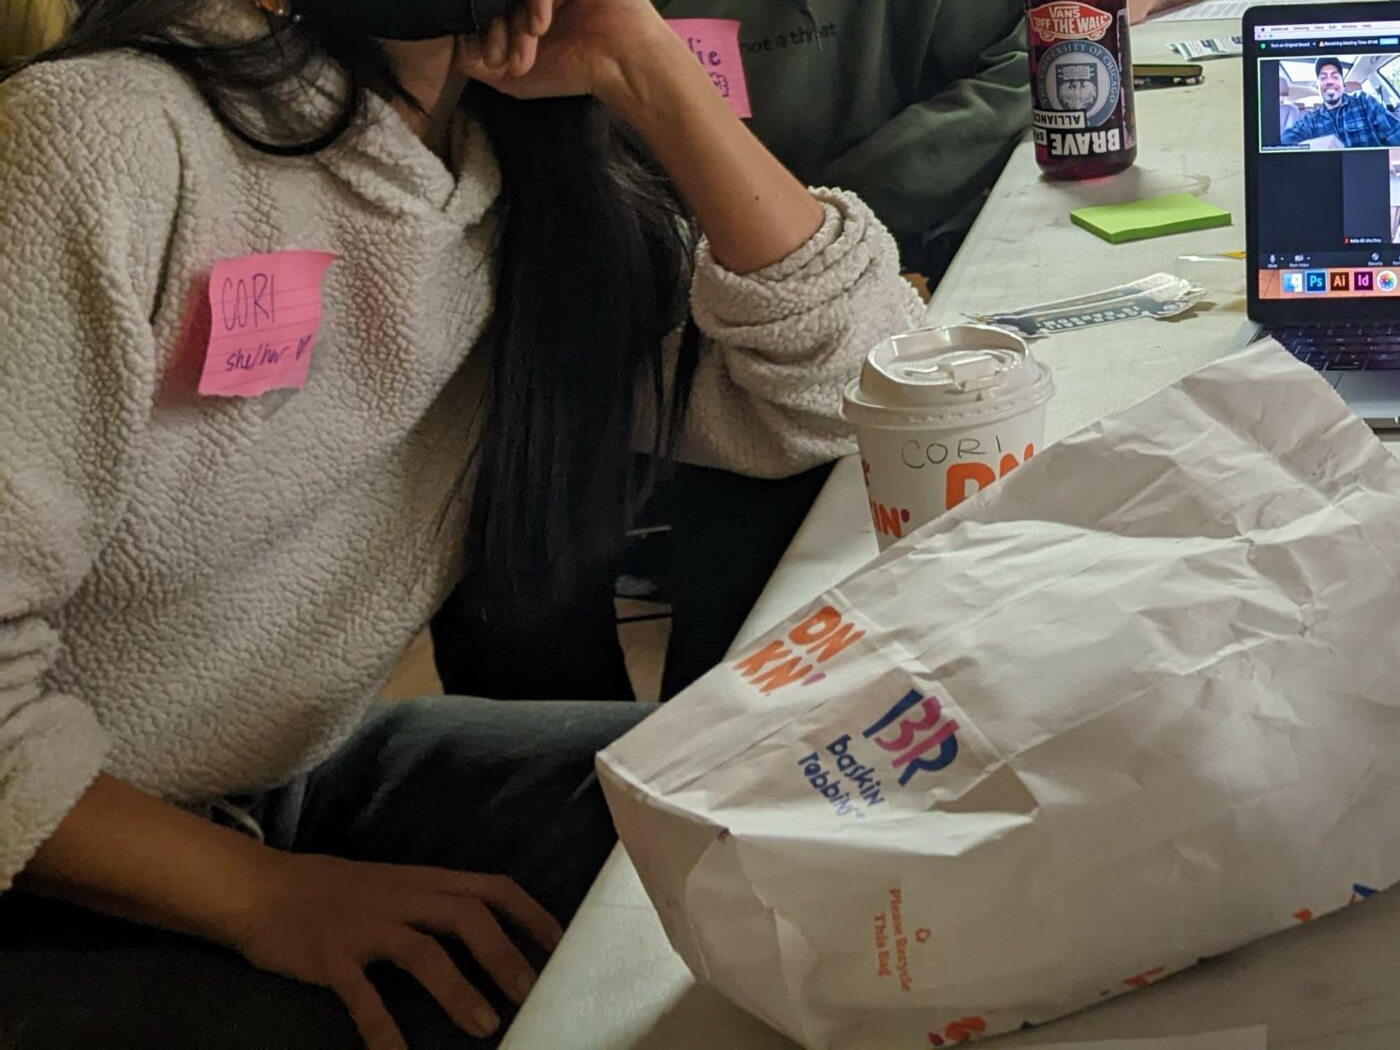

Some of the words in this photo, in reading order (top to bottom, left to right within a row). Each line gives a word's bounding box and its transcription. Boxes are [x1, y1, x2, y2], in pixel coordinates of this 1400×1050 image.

[1048, 6, 1081, 18] VANS
[1051, 17, 1077, 34] THE
[1039, 41, 1087, 79] UNIVERSITY
[1089, 46, 1103, 58] OF
[1103, 56, 1119, 104] CHICAGO
[1051, 128, 1120, 156] BRAVE
[1310, 276, 1323, 288] Ps
[1333, 276, 1346, 287] Ai
[1358, 275, 1369, 286] Id
[222, 273, 275, 331] CORI
[901, 435, 1002, 470] CORI
[862, 688, 961, 788] BR
[826, 734, 886, 807] baskin
[873, 912, 887, 950] This
[889, 888, 903, 936] Please
